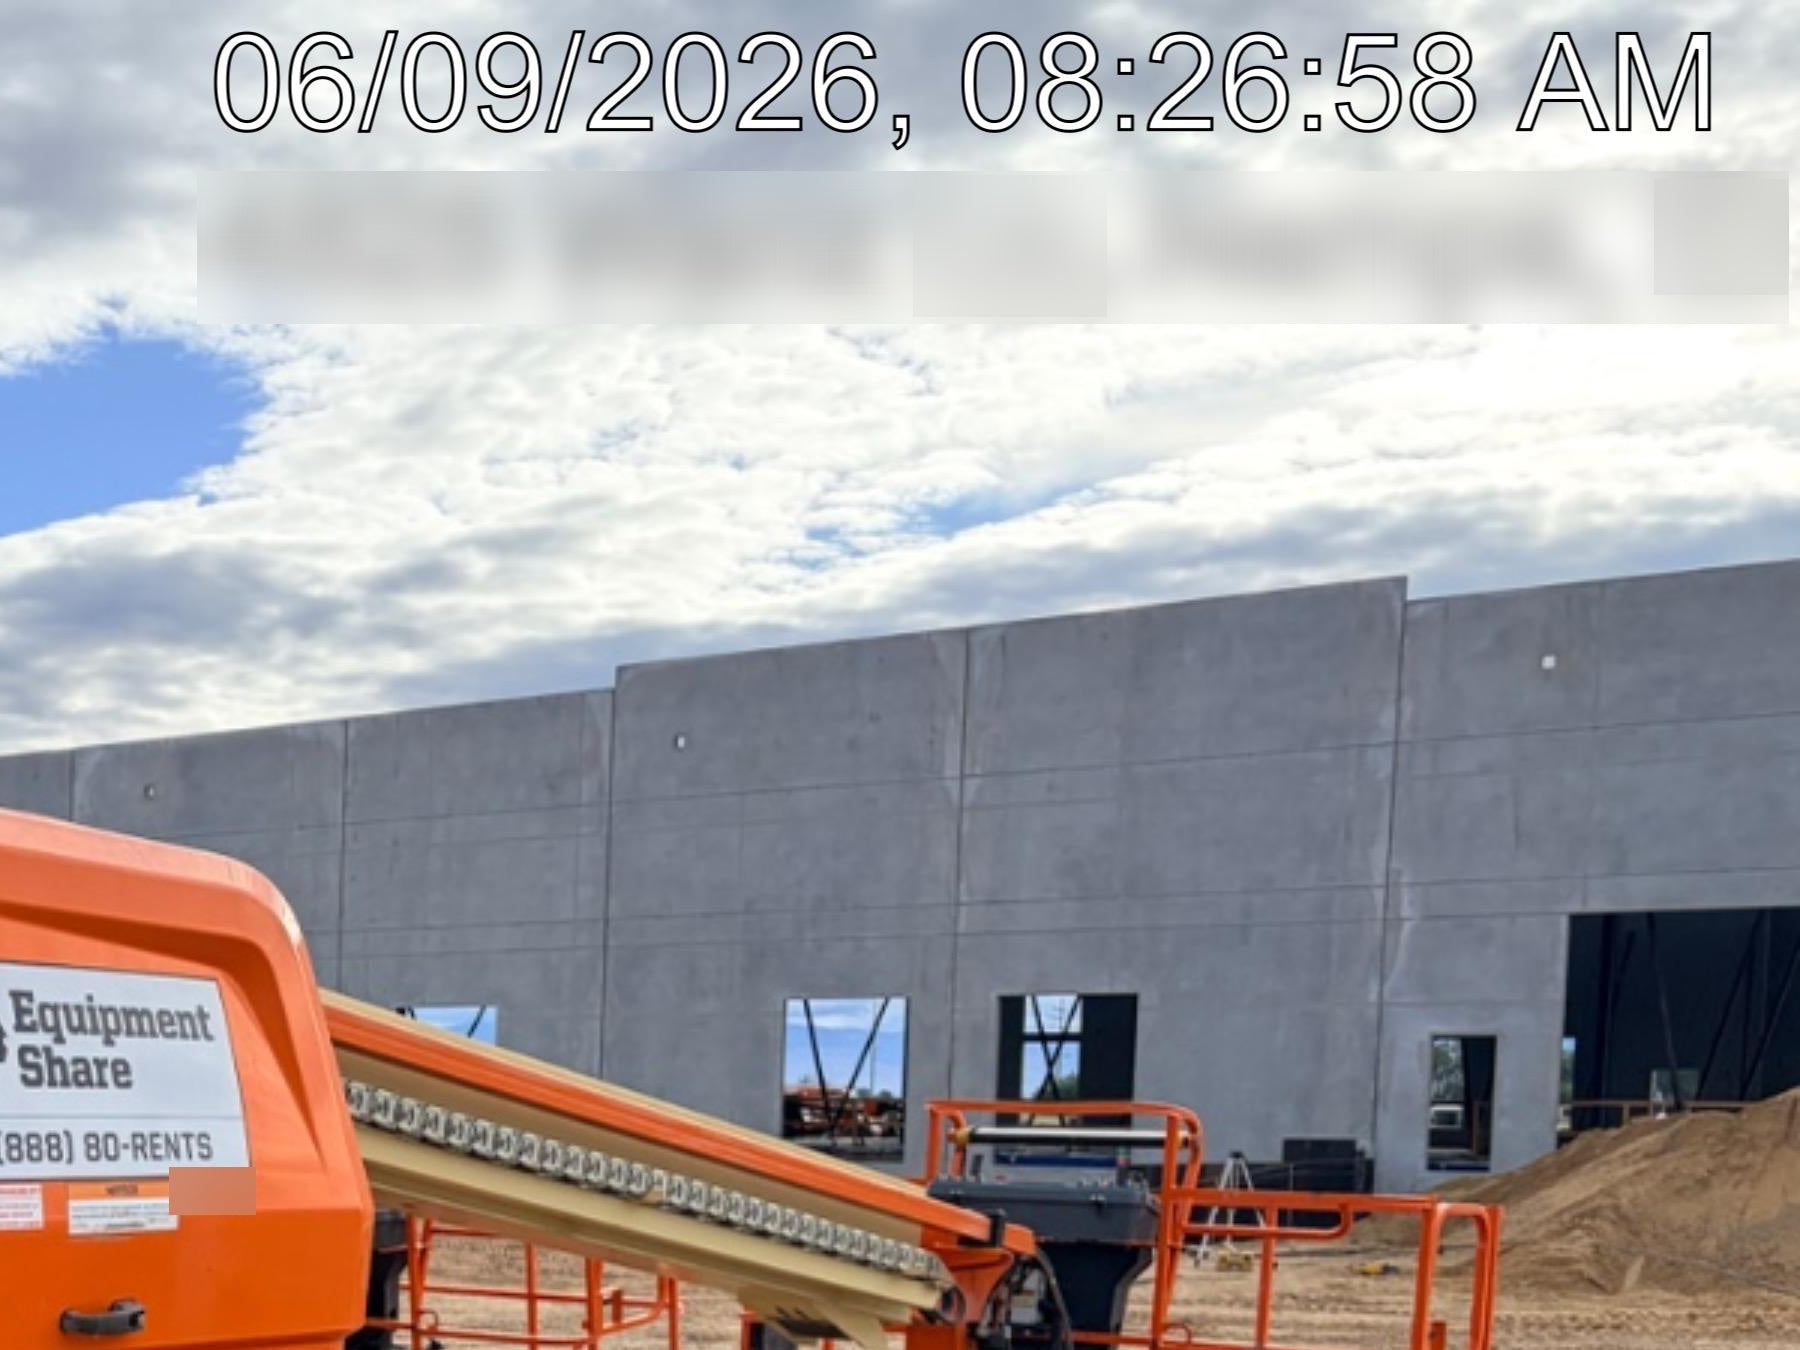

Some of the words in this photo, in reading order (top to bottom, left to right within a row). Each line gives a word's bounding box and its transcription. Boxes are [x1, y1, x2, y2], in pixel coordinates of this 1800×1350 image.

[9, 989, 214, 1046] Equipment
[18, 1044, 132, 1089] Share
[84, 1132, 213, 1162] 80-RENTS
